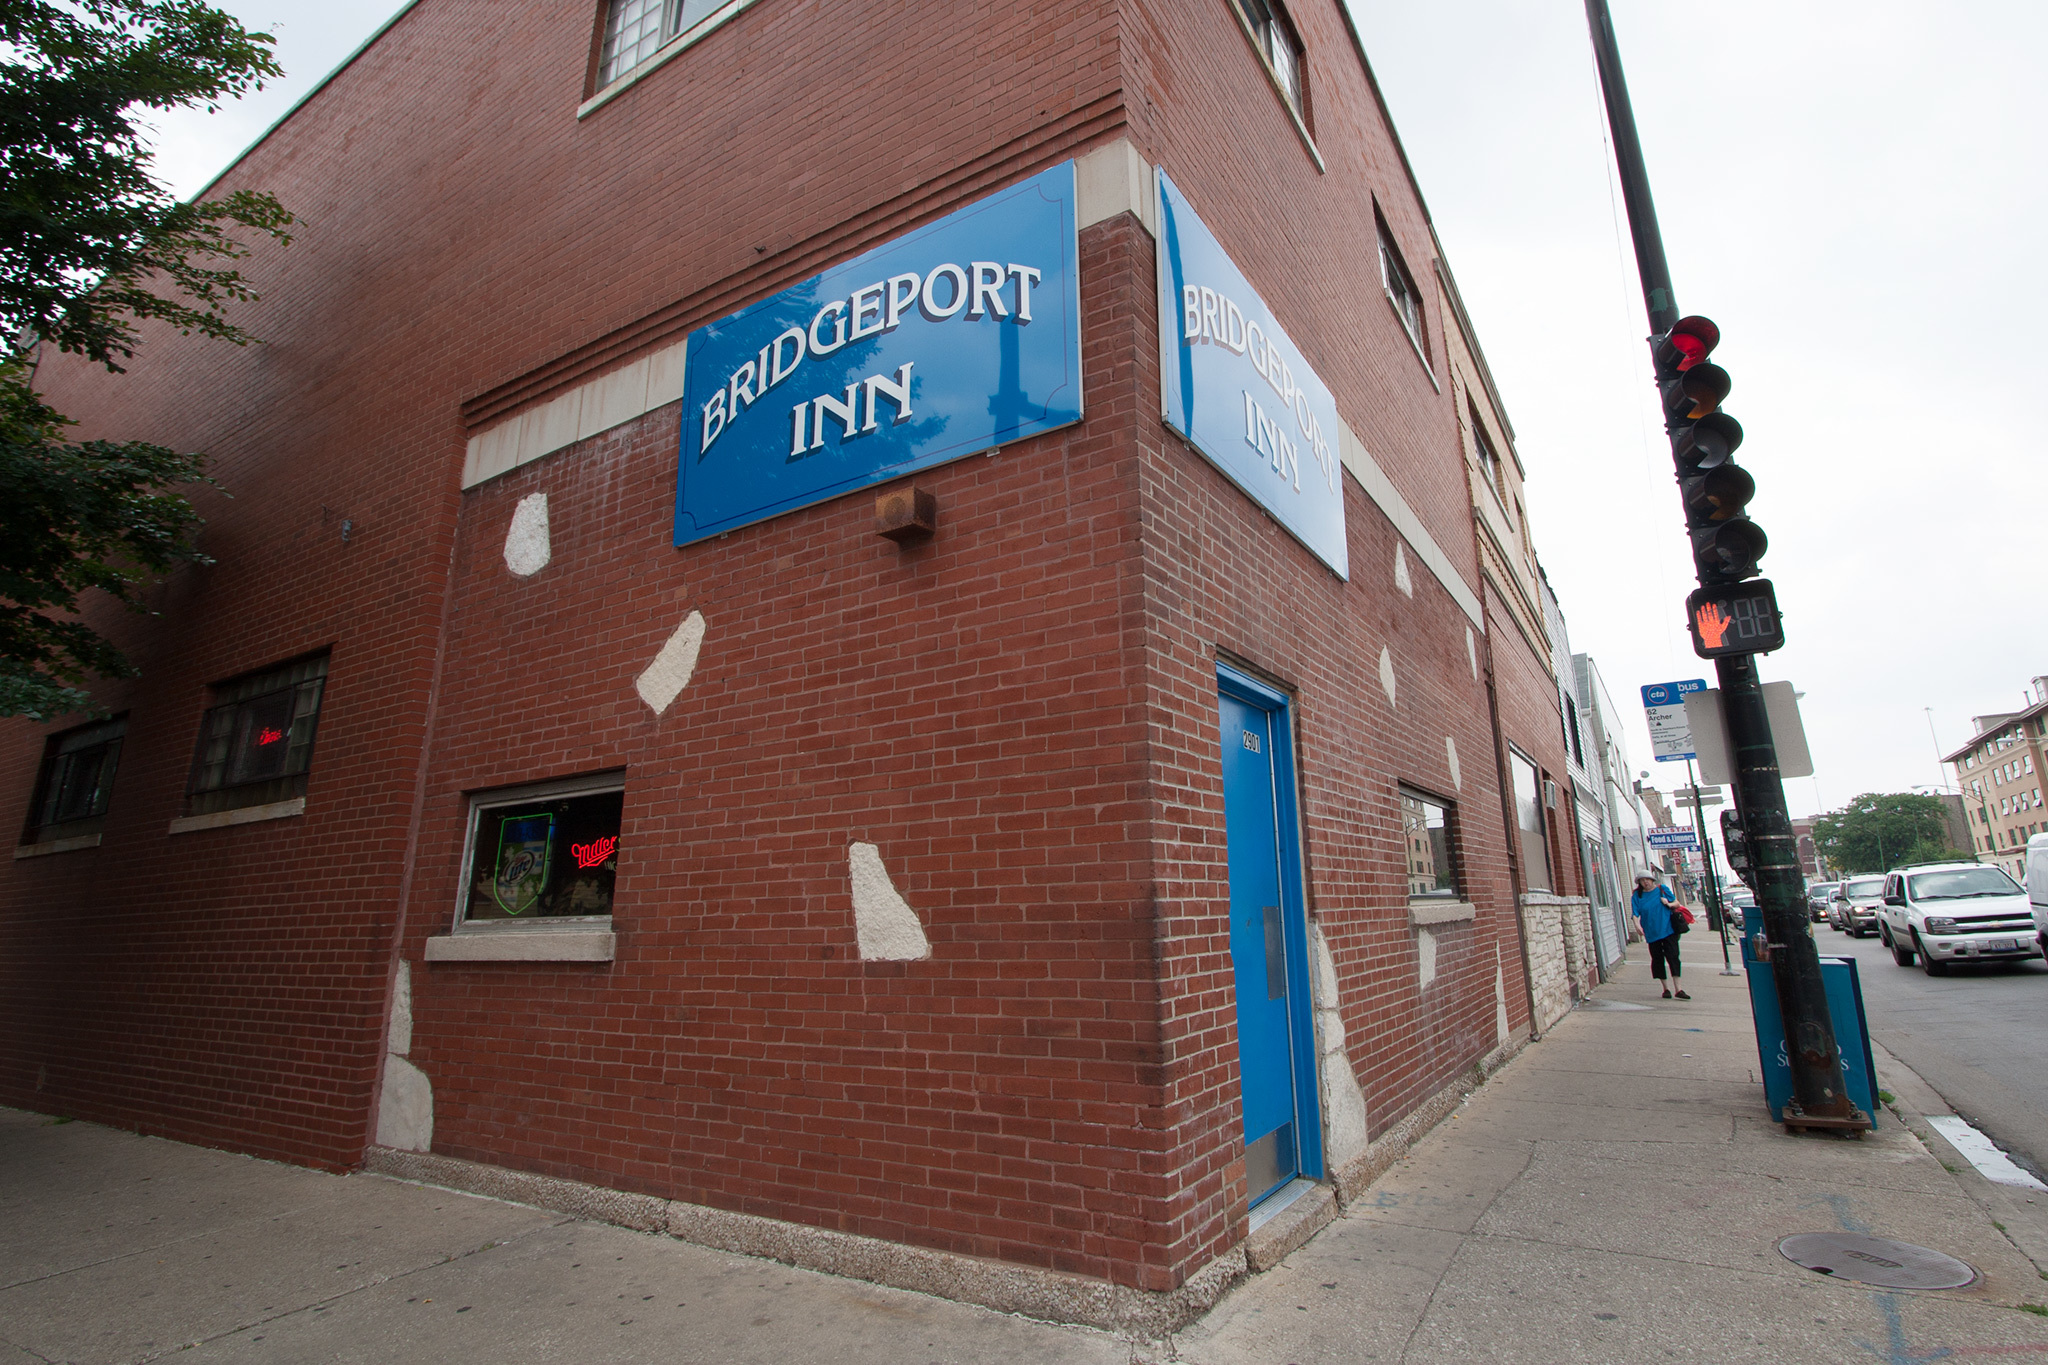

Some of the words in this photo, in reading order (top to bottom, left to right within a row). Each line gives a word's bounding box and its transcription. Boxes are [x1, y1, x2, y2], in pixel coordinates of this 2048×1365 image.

[699, 261, 1041, 459] BRIDGEPORT
[1182, 283, 1335, 494] BRIDGEPORT
[788, 361, 915, 460] INN
[1242, 388, 1301, 494] INN
[1677, 682, 1699, 692] bus
[1243, 731, 1260, 753] 2901
[571, 836, 618, 869] Miller
[1671, 834, 1695, 842] Liquors
